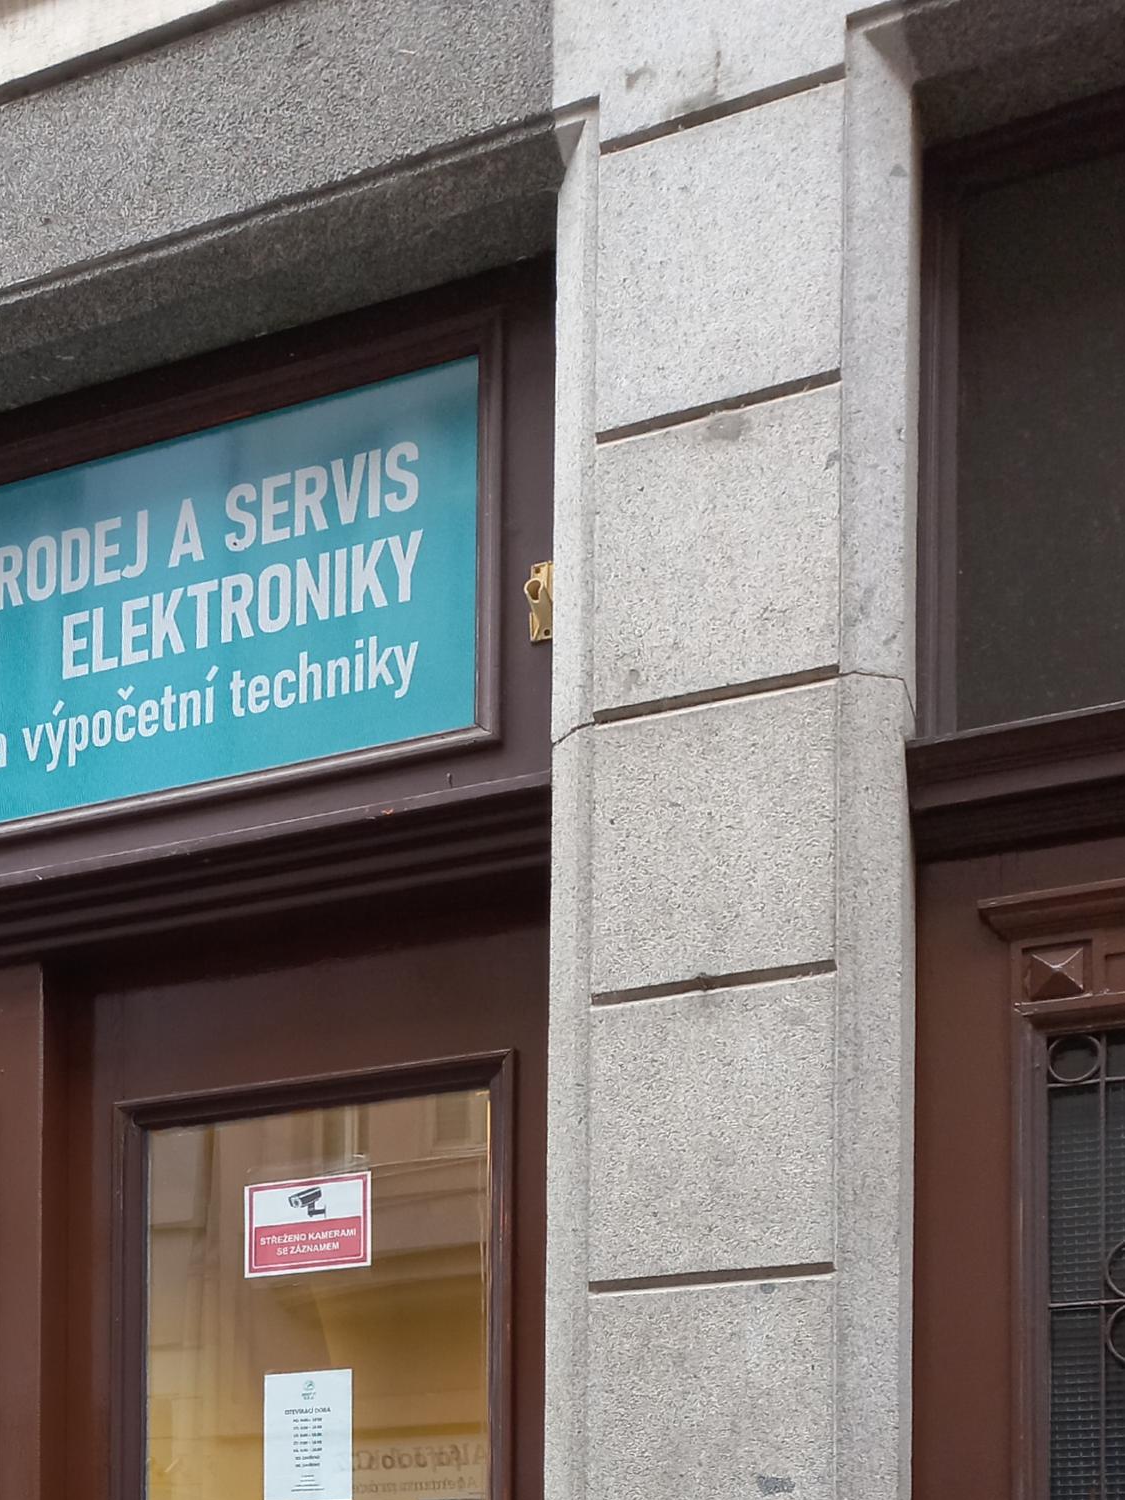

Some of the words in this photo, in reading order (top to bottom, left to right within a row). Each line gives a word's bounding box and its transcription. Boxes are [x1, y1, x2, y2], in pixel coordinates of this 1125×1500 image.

[168, 498, 205, 568] A
[225, 441, 420, 551] SERVIS
[61, 528, 424, 680] ELEKTRONIKY
[22, 666, 219, 773] výpočetní
[230, 636, 419, 718] techniky
[260, 1232, 306, 1246] STŘEŽENO
[308, 1228, 356, 1240] KAMERAMI
[276, 1247, 288, 1256] SE
[290, 1242, 339, 1254] ZÁZNAMEM
